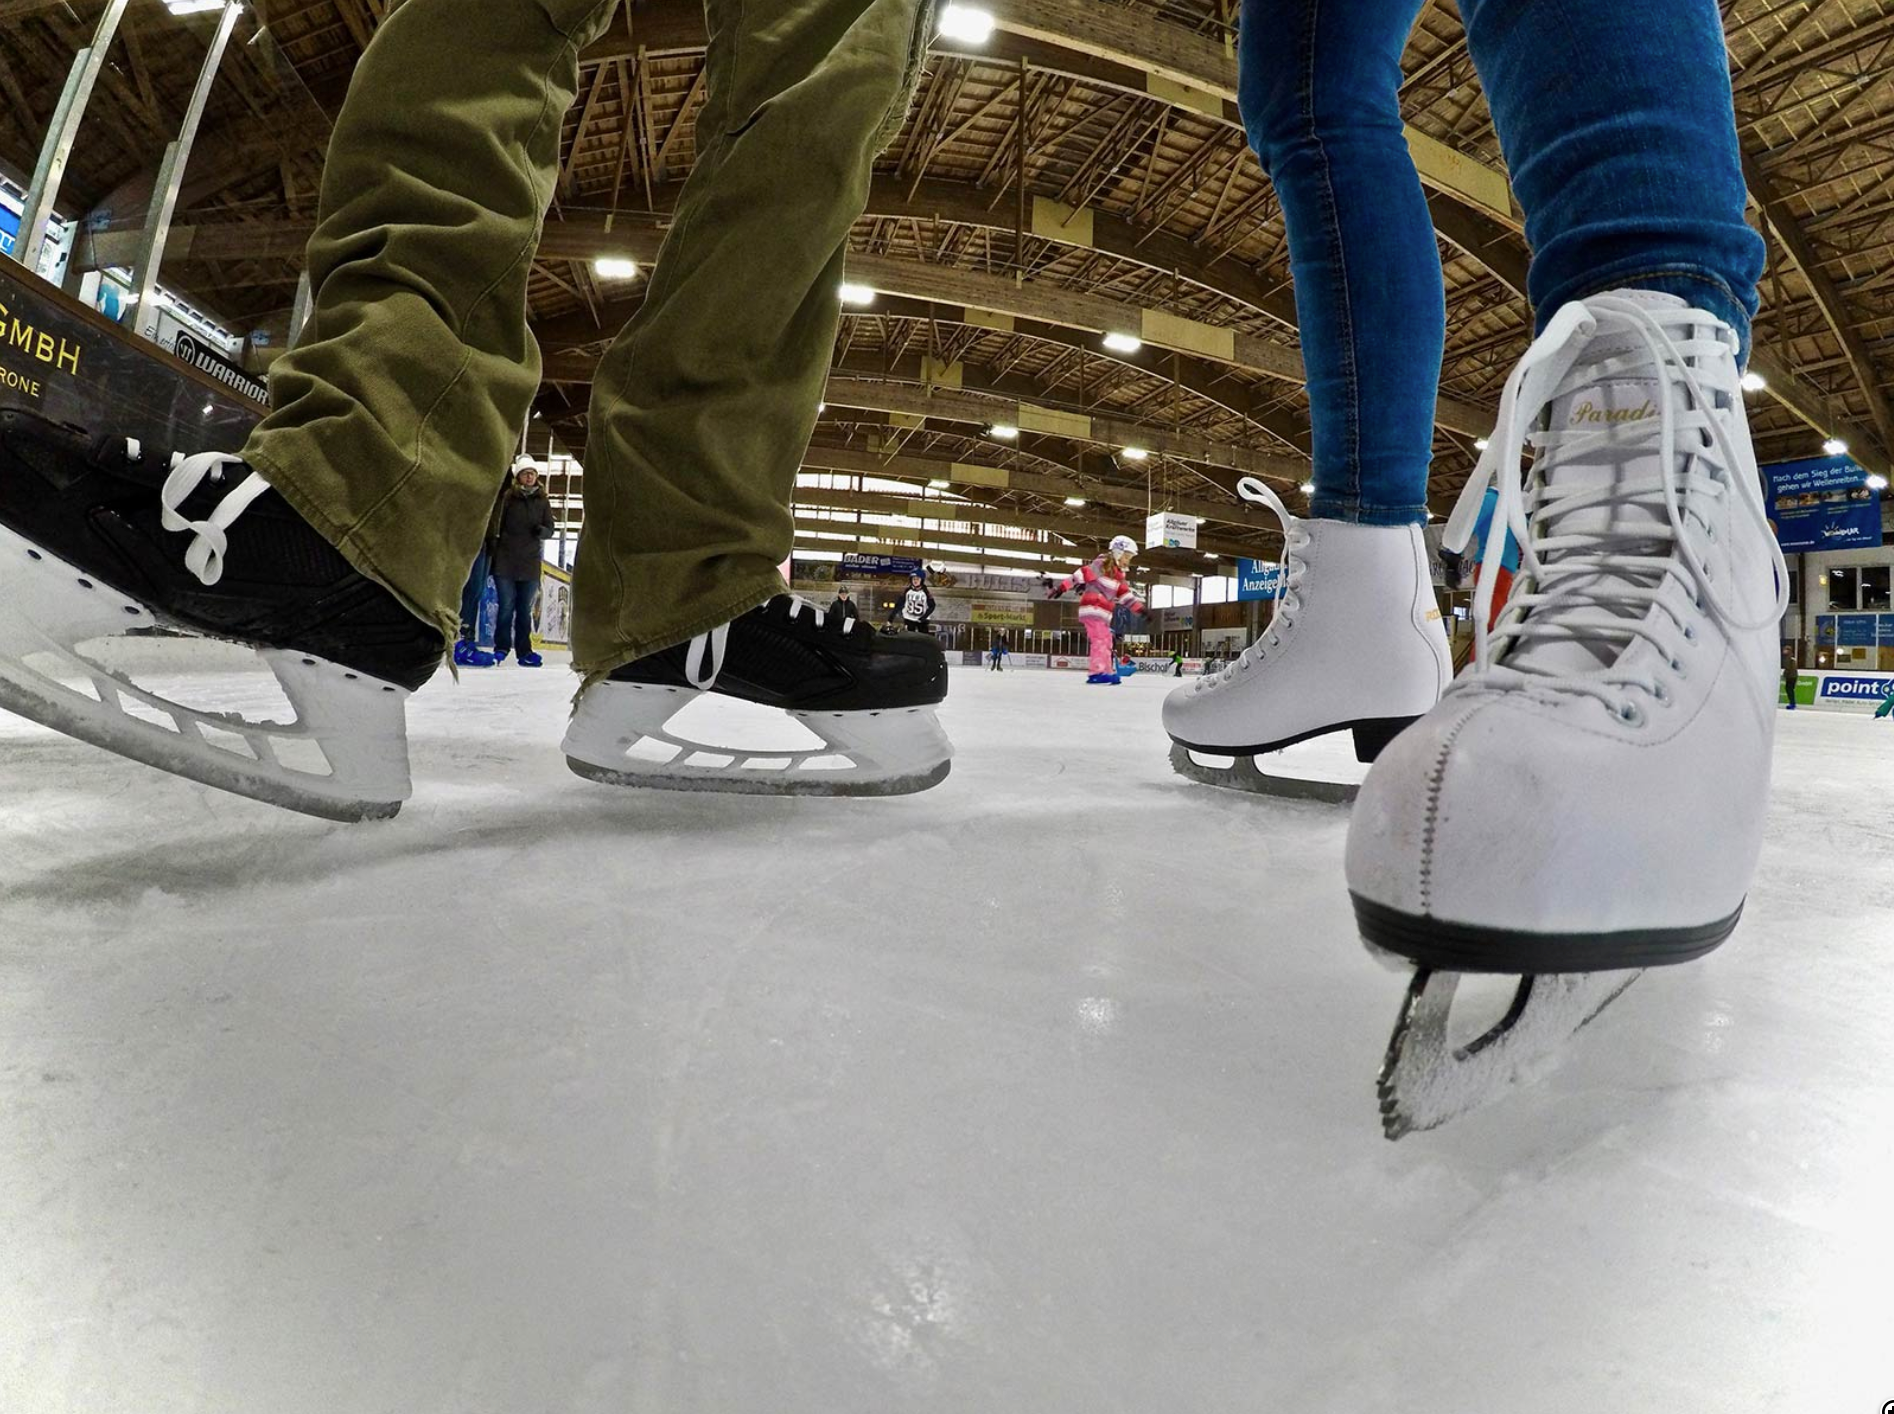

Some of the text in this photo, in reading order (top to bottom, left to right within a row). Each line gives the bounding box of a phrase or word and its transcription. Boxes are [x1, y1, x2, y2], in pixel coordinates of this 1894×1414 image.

[195, 352, 270, 405] WARRIOR
[1570, 399, 1660, 425] Paradi
[1793, 472, 1809, 480] dem
[1811, 469, 1828, 478] Sieg
[1830, 467, 1842, 475] der
[1827, 680, 1879, 695] point
